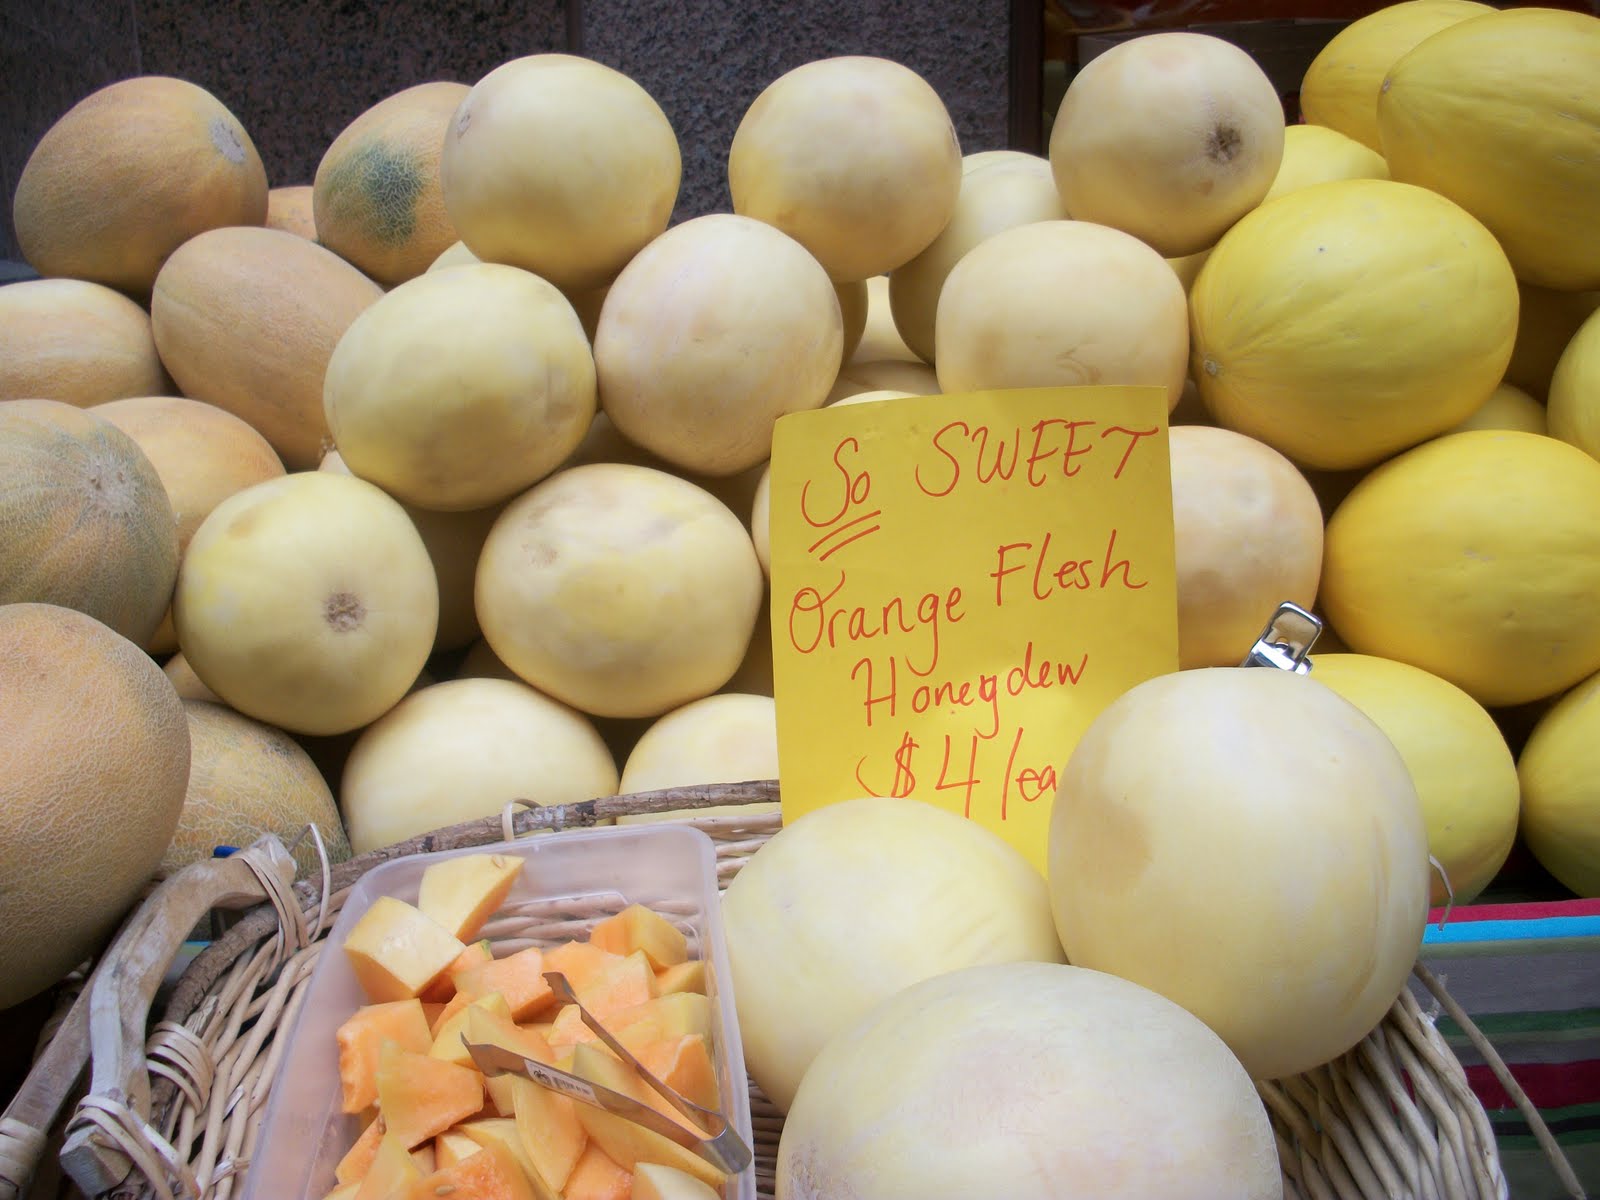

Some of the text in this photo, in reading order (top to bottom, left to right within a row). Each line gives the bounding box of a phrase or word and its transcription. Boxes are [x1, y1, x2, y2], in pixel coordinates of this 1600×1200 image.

[801, 419, 1159, 527] So SWEET
[789, 529, 1149, 676] Orange Flesh
[851, 641, 1089, 739] Honeydew
